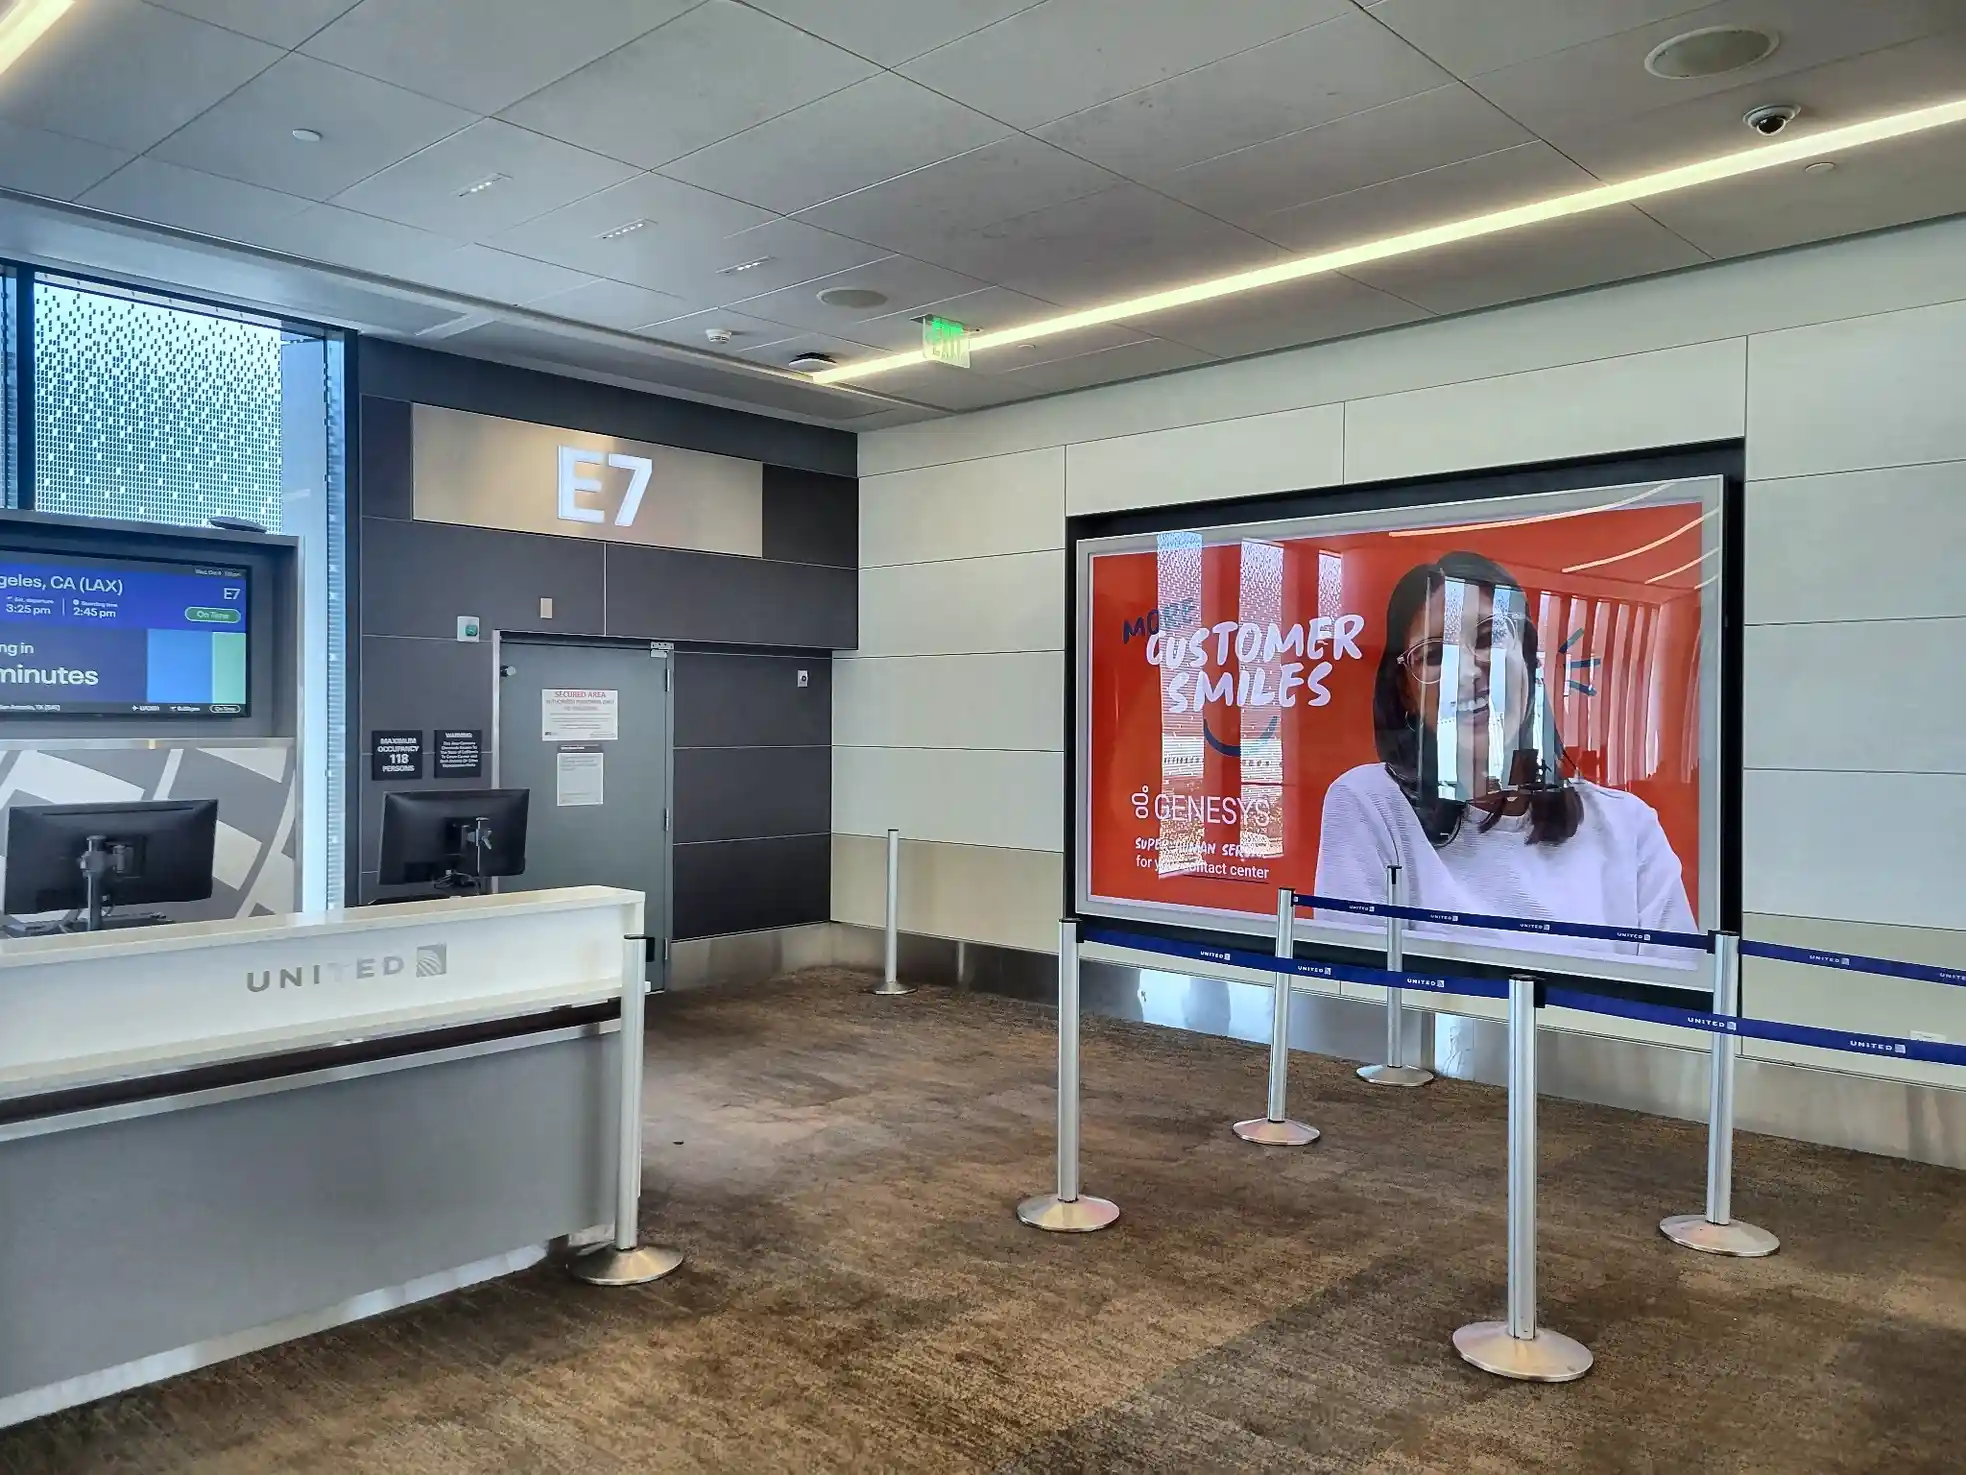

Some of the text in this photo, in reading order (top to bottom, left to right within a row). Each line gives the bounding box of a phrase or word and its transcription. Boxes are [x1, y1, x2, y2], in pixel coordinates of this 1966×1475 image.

[557, 445, 653, 527] E7
[50, 576, 76, 590] CA
[79, 576, 123, 596] (LAX)
[223, 587, 241, 600] E7
[6, 603, 51, 616] 3:25 pm
[73, 606, 117, 619] 2:45 pm
[20, 641, 34, 654] in
[1146, 614, 1365, 670] CUSTOMER
[1168, 662, 1333, 713] SMILES
[380, 737, 417, 745] MAXIMUM
[377, 745, 420, 753] OCCUPANCY
[390, 753, 409, 764] 118
[1154, 793, 1270, 827] GENESYS
[1136, 855, 1152, 868] for
[1230, 864, 1269, 879] center
[1200, 950, 1224, 959] UNITED
[1809, 954, 1840, 963] UNITED
[247, 956, 405, 992] UNITED
[1297, 965, 1324, 974] UNITED
[1407, 978, 1436, 987] UNITED
[1687, 1017, 1725, 1028] UNITED
[1850, 1040, 1893, 1051] UNITED
